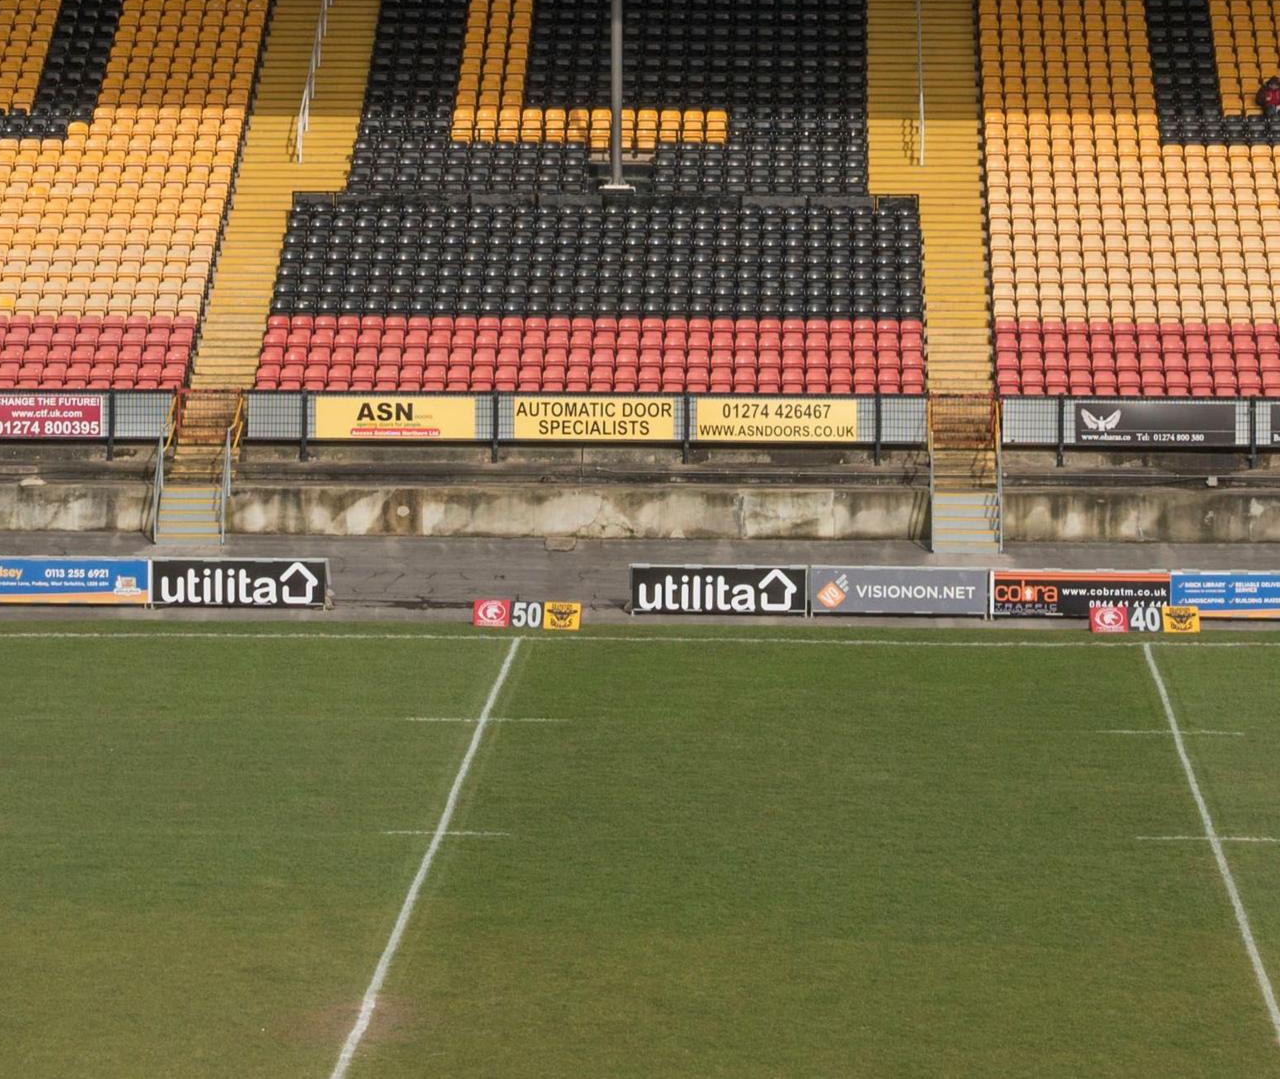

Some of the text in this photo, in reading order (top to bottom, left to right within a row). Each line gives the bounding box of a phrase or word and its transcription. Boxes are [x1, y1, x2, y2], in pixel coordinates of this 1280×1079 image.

[38, 397, 58, 406] THE
[60, 397, 100, 406] FUTURE!
[11, 409, 83, 419] www.ctf.uk.com
[357, 403, 413, 421] ASN
[516, 402, 672, 418] AUTOMATIC DOOR
[722, 404, 831, 419] 01274 426467
[43, 421, 99, 435] 800395
[538, 420, 650, 436] SPECIALISTS
[699, 424, 855, 438] WWW.ASNDOORS.CO.UK
[1136, 433, 1150, 441] Tel:
[1153, 433, 1175, 441] 01274
[1176, 433, 1190, 441] 800
[45, 569, 66, 578] 0113
[68, 569, 86, 578] 255
[87, 569, 109, 578] 6921
[161, 567, 278, 604] utilita
[638, 575, 756, 611] utilita
[856, 585, 976, 600] VISIONON.NET
[995, 580, 1058, 602] cobra
[1062, 587, 1168, 597] www.cobratm.co.uk
[512, 602, 542, 628] 50
[1130, 607, 1161, 632] 40
